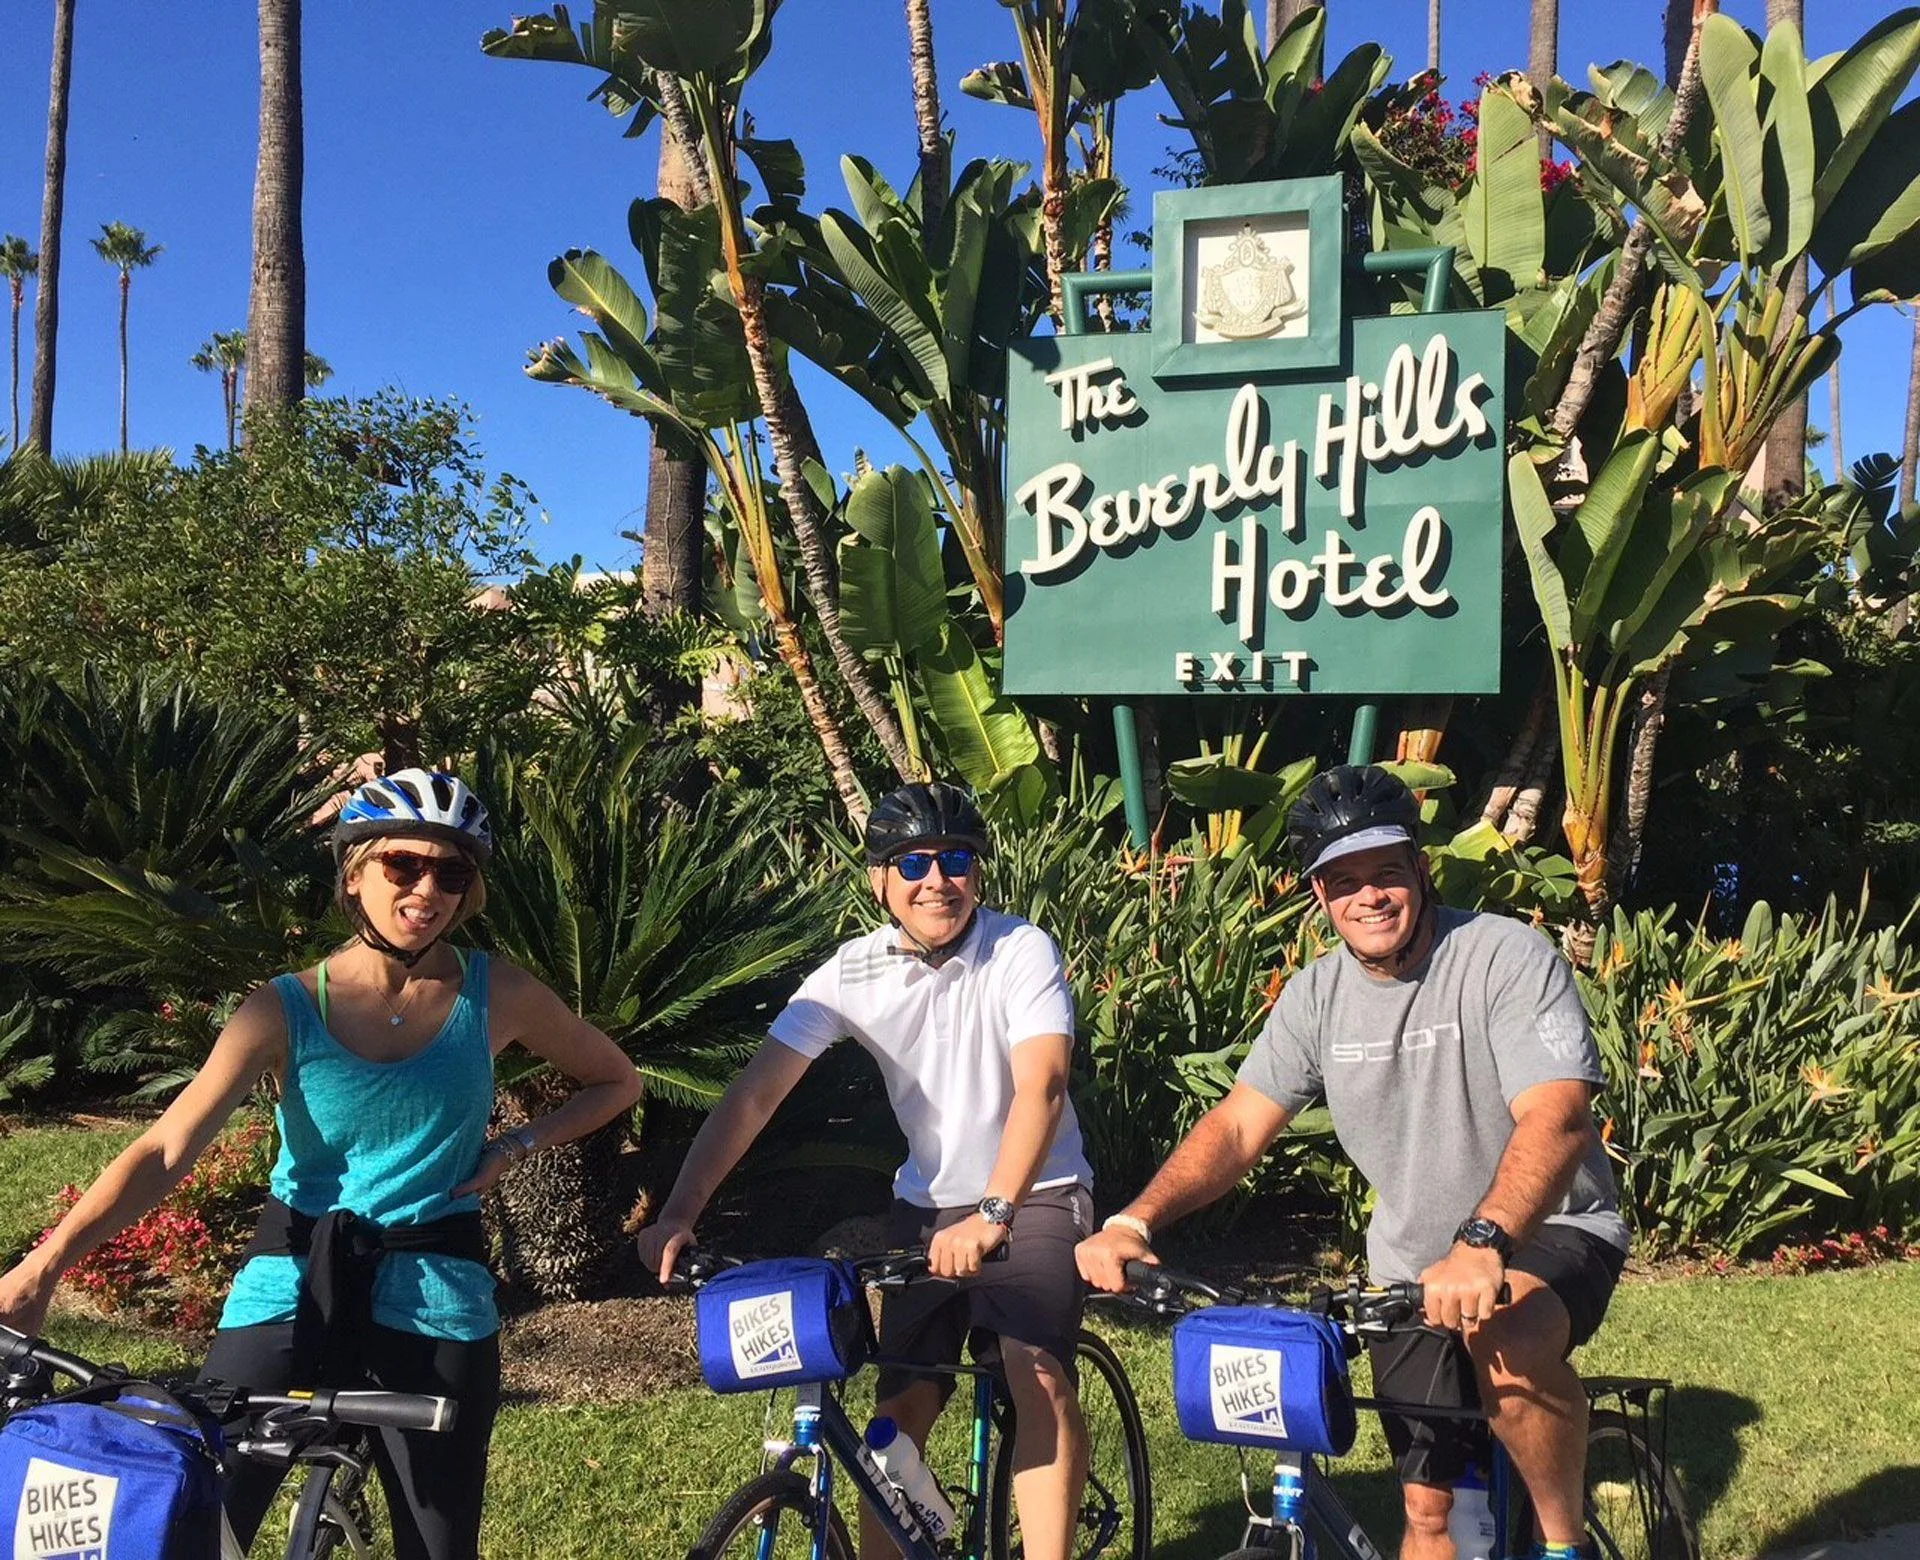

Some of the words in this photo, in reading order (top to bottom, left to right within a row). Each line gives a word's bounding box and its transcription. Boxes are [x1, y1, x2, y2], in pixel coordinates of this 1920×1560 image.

[1045, 358, 1137, 430] The
[1014, 383, 1297, 575] Beverly
[1314, 333, 1487, 517] Hills
[1211, 505, 1450, 643] Hotel
[1175, 651, 1307, 681] EXIT
[733, 1297, 781, 1338] BIKES
[740, 1319, 790, 1361] HIKES
[1213, 1353, 1268, 1387] BIKES
[1221, 1382, 1276, 1414] HIKES
[26, 1479, 98, 1515] BIKES
[29, 1516, 102, 1552] HIKES
